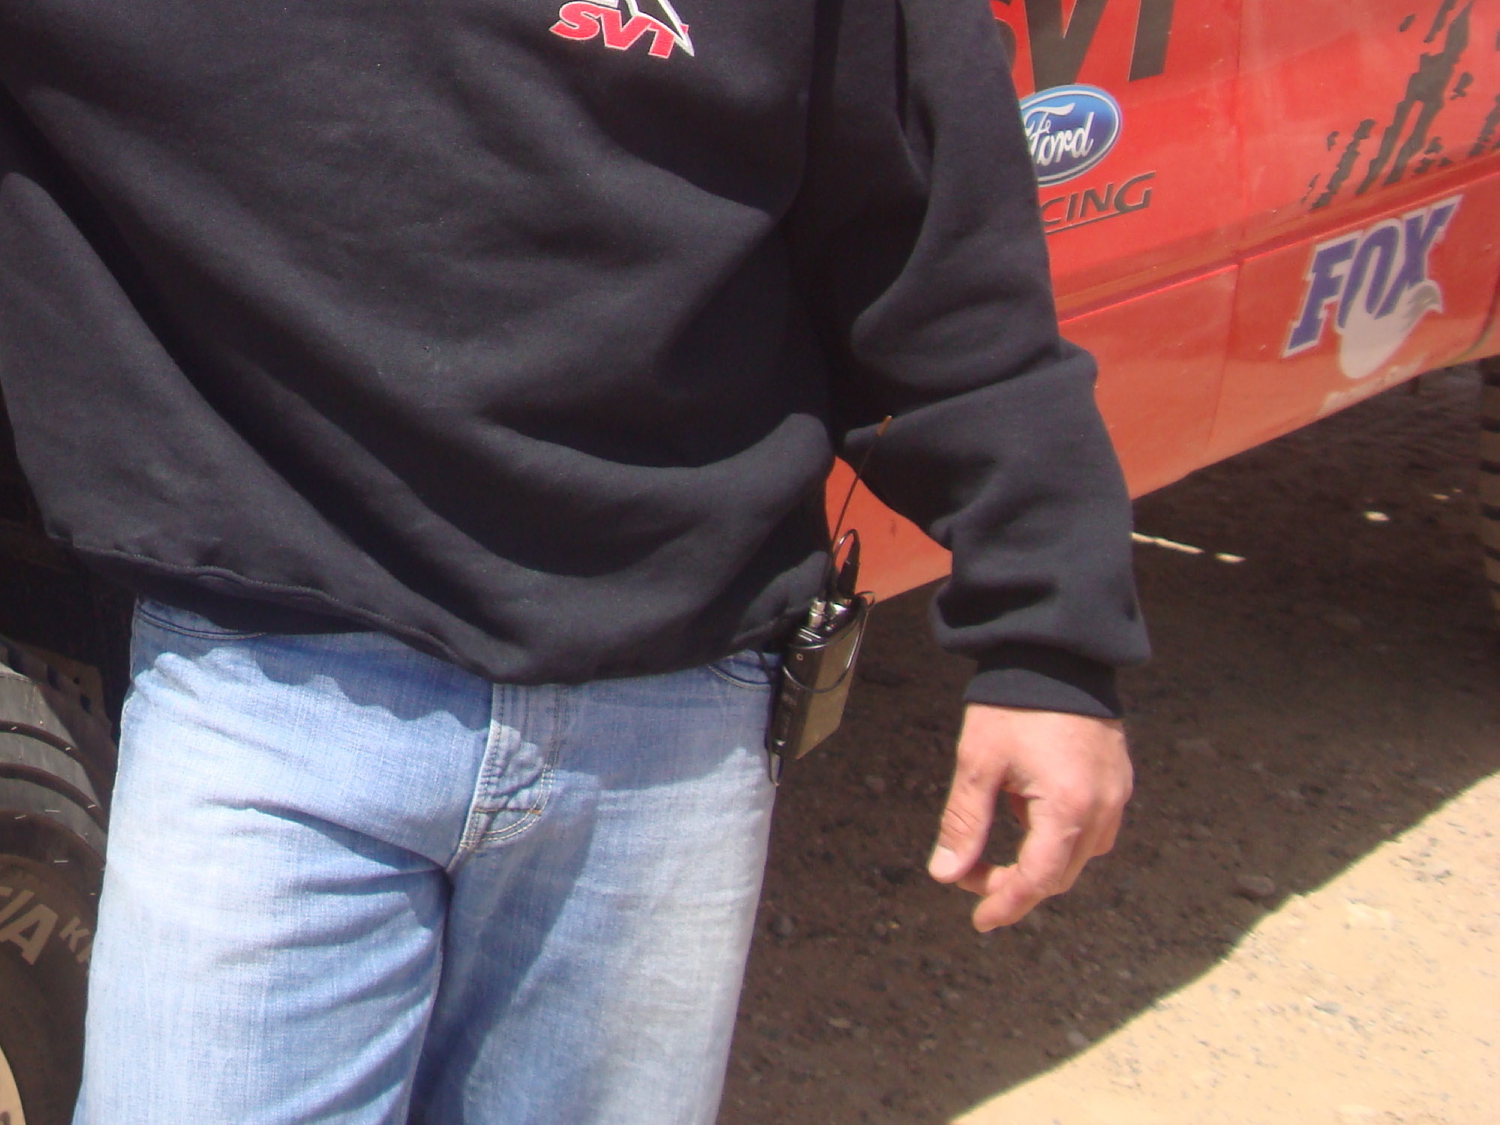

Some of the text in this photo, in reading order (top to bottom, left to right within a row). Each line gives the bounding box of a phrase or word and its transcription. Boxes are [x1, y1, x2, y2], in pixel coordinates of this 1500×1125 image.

[548, 0, 690, 60] SVT
[1023, 102, 1096, 166] Ford
[1040, 170, 1156, 225] CING
[1286, 200, 1458, 353] FOX
